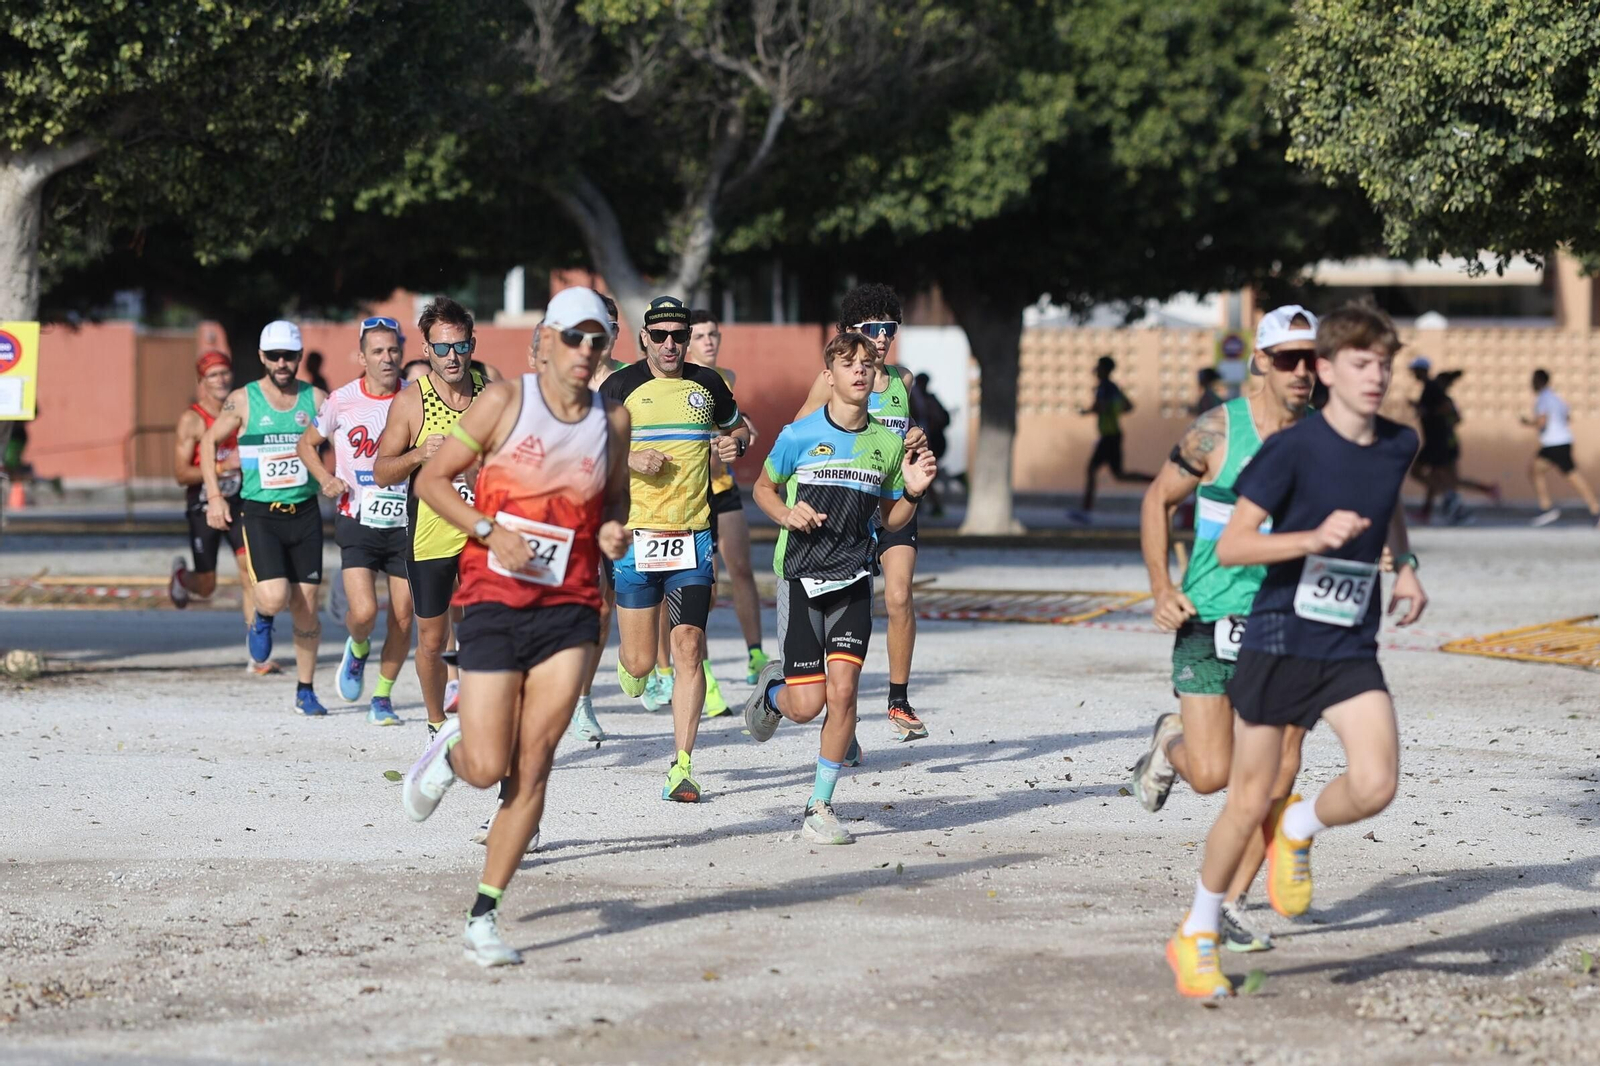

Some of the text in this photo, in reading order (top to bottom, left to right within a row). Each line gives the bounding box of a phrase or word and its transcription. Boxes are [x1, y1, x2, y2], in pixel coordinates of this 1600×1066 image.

[266, 459, 299, 477] 325
[813, 469, 881, 485] TORREMOLINOS
[369, 500, 404, 517] 465
[645, 538, 684, 558] 218
[1314, 575, 1368, 604] 905
